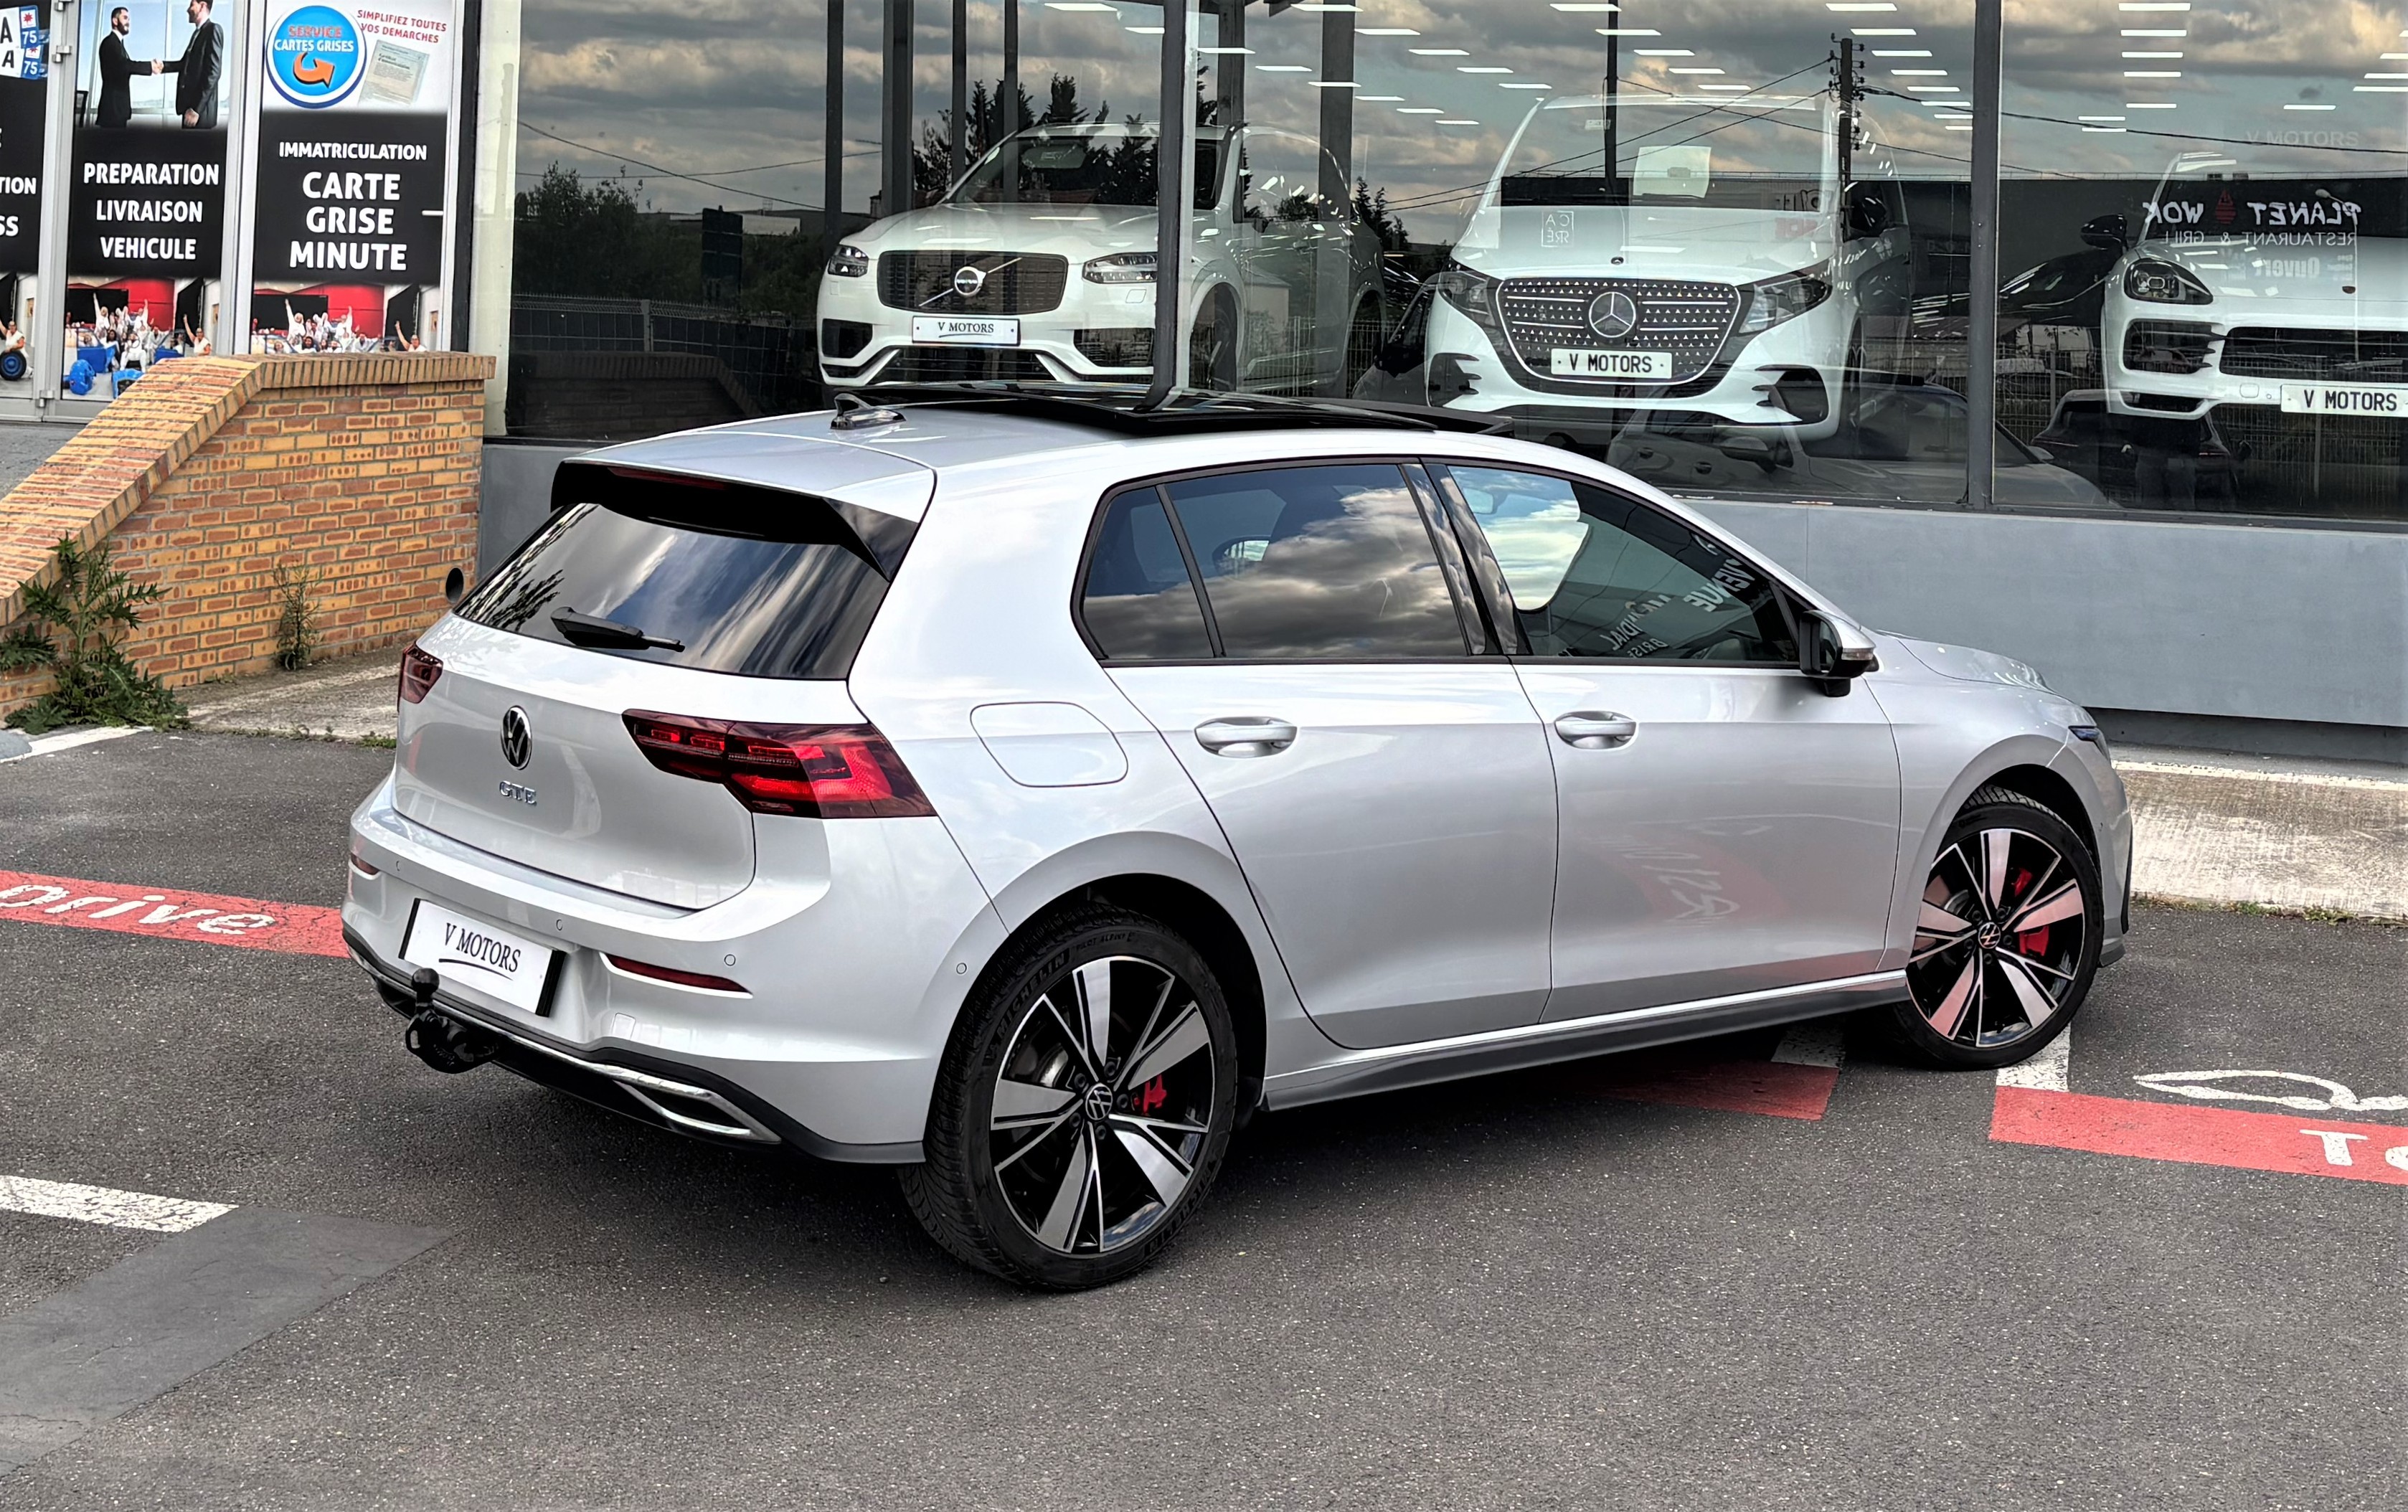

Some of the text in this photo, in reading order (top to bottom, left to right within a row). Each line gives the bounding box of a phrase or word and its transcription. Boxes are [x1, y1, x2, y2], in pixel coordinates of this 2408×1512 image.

[288, 24, 342, 38] SERVICE
[357, 9, 447, 32] SIMPLIFIEZ TOUTES
[22, 30, 37, 44] 75
[361, 23, 439, 43] VOS DEMARCHES
[274, 39, 354, 52] CARTES GRISES
[24, 60, 38, 75] 75
[2267, 131, 2360, 146] MOTORS
[279, 141, 428, 160] IMMATRICULATION
[83, 162, 219, 185] PREPARATION
[303, 171, 400, 201] CARTE
[96, 199, 203, 222] LIVRAISON
[306, 206, 394, 235] GRISE
[100, 237, 197, 260] VEHICULE
[290, 240, 407, 270] MINUTE
[938, 322, 994, 333] V MOTORS
[1569, 354, 1652, 373] V MOTORS
[2304, 389, 2397, 411] V MOTORS
[499, 780, 537, 806] GTE
[445, 922, 521, 973] V MOTORS
